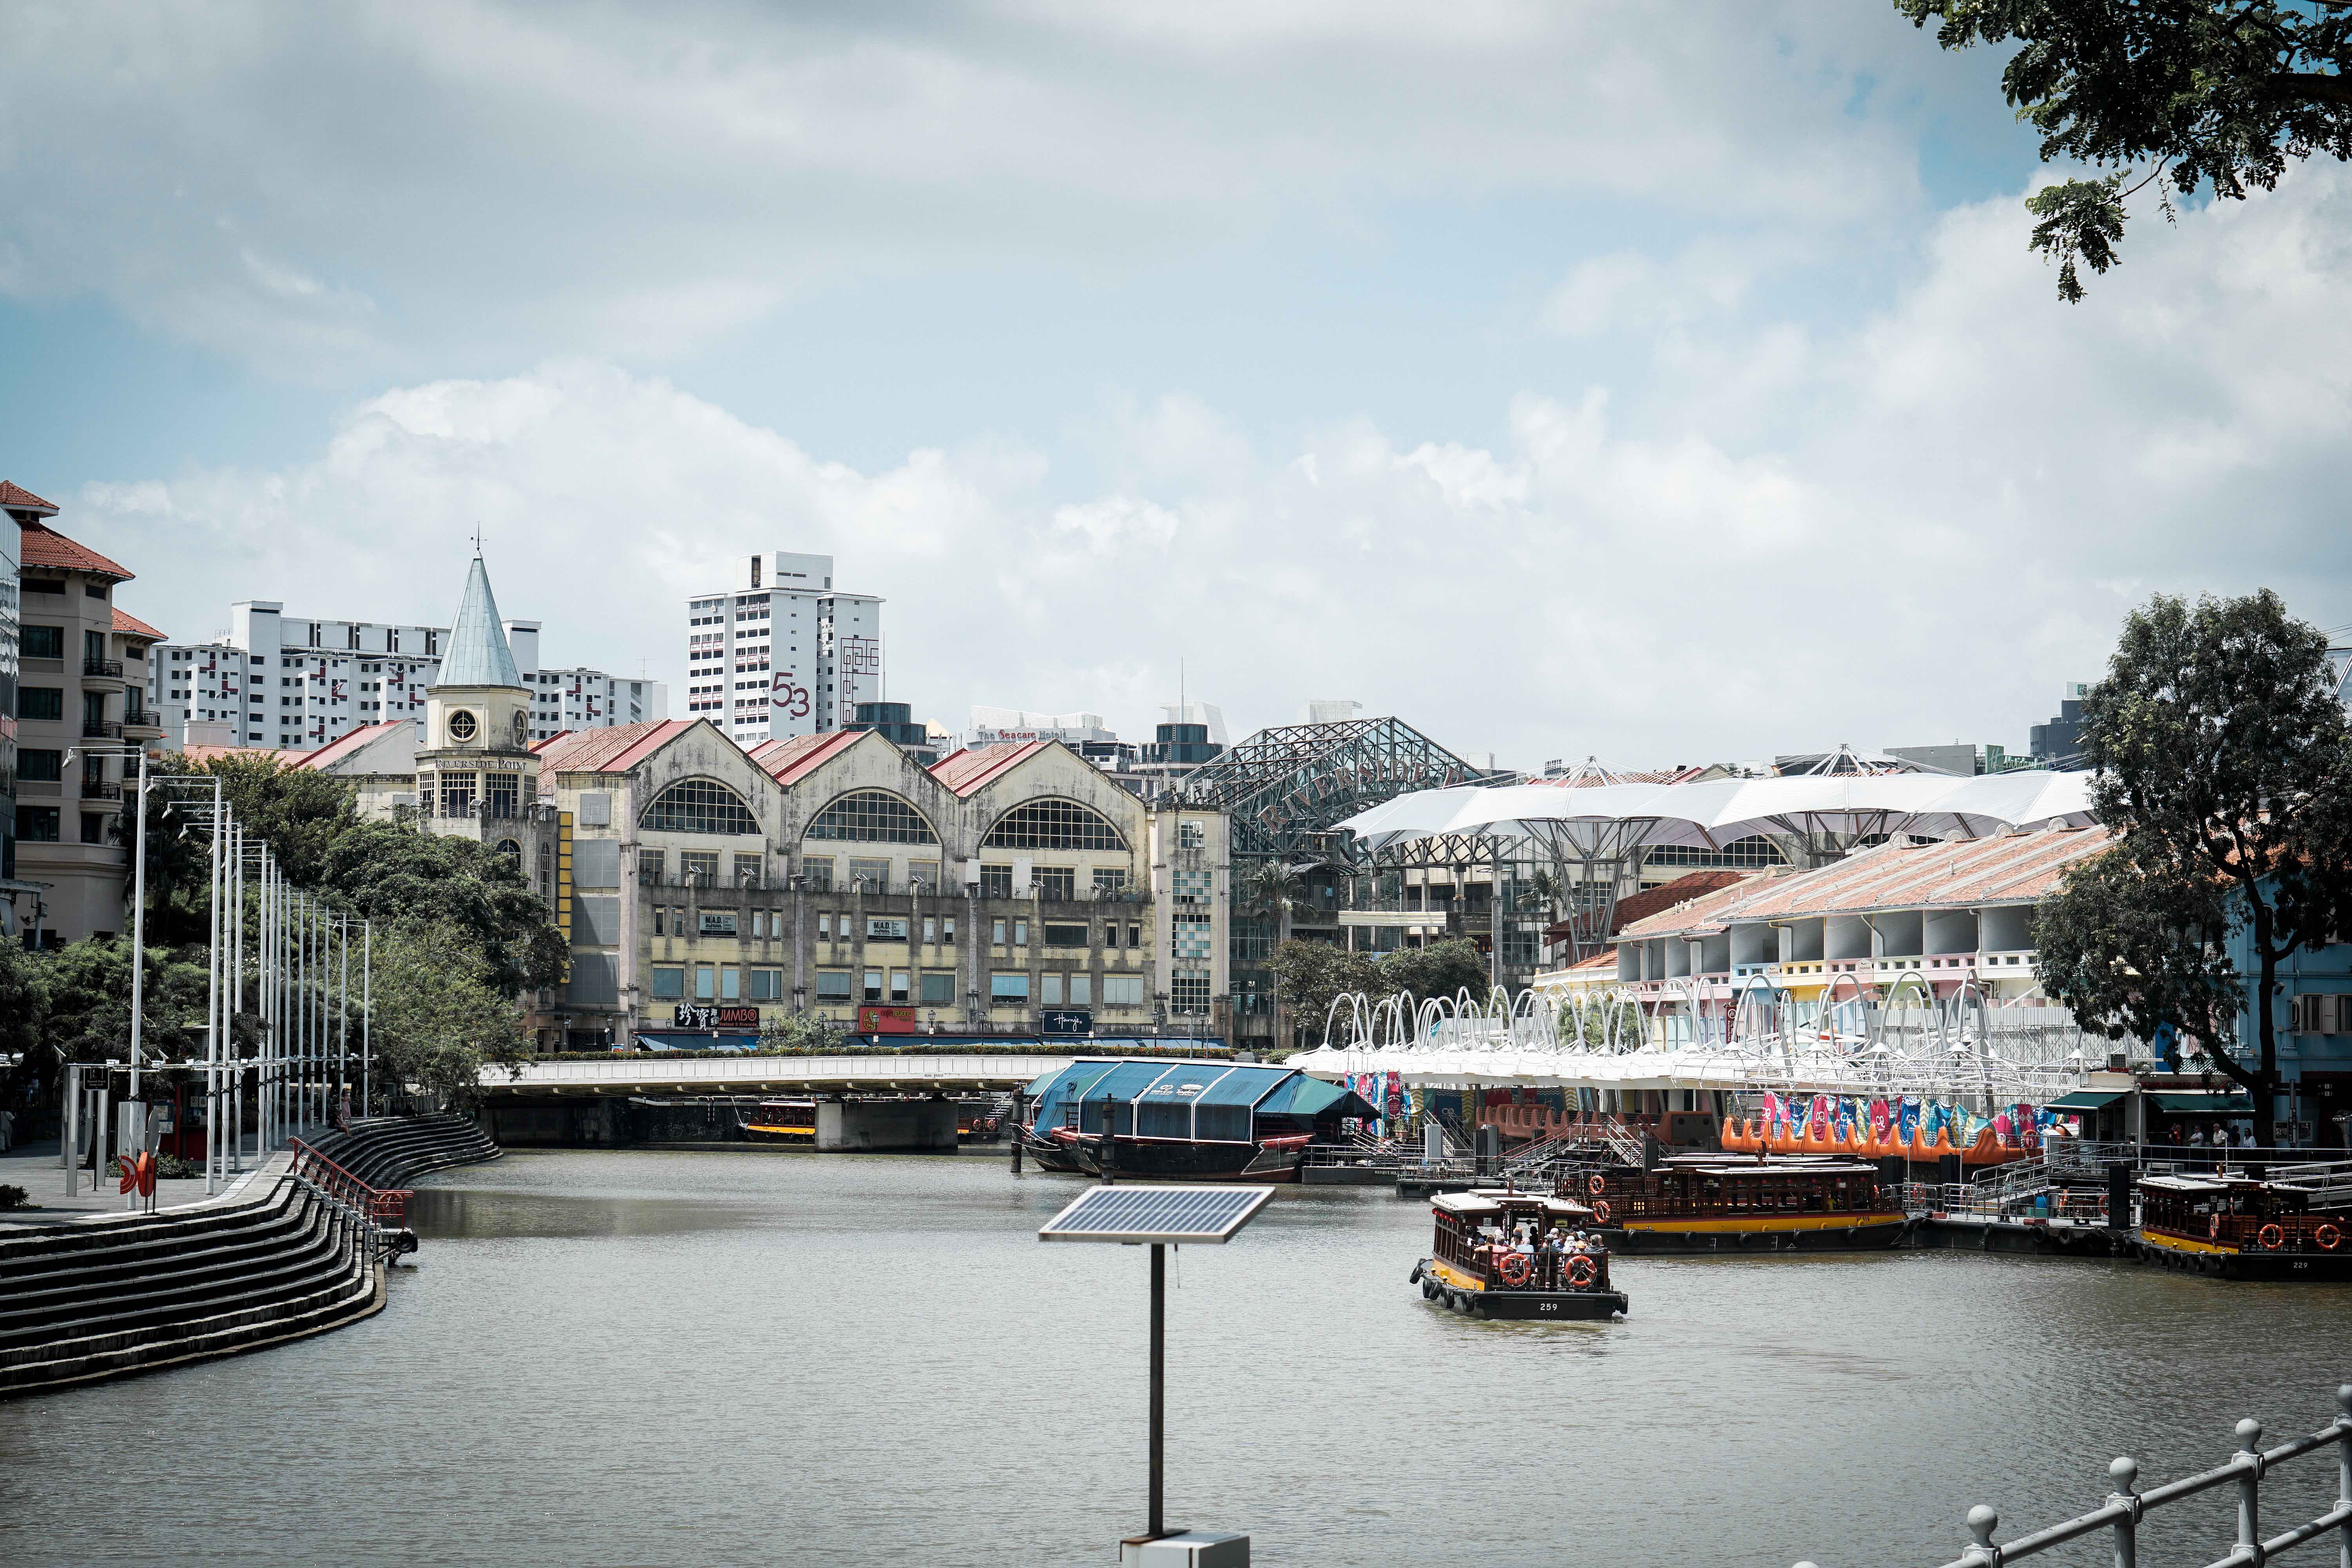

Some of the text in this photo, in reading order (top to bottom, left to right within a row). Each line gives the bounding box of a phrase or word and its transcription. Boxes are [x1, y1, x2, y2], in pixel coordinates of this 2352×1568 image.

[772, 672, 809, 717] 53
[998, 729, 1036, 739] Seacare
[1039, 730, 1062, 739] Hotel
[436, 759, 527, 770] RIVERSIDE POINT
[1257, 760, 1429, 834] RIVERSIDE
[719, 1009, 757, 1021] JUMBO
[1053, 1013, 1079, 1032] Harry's
